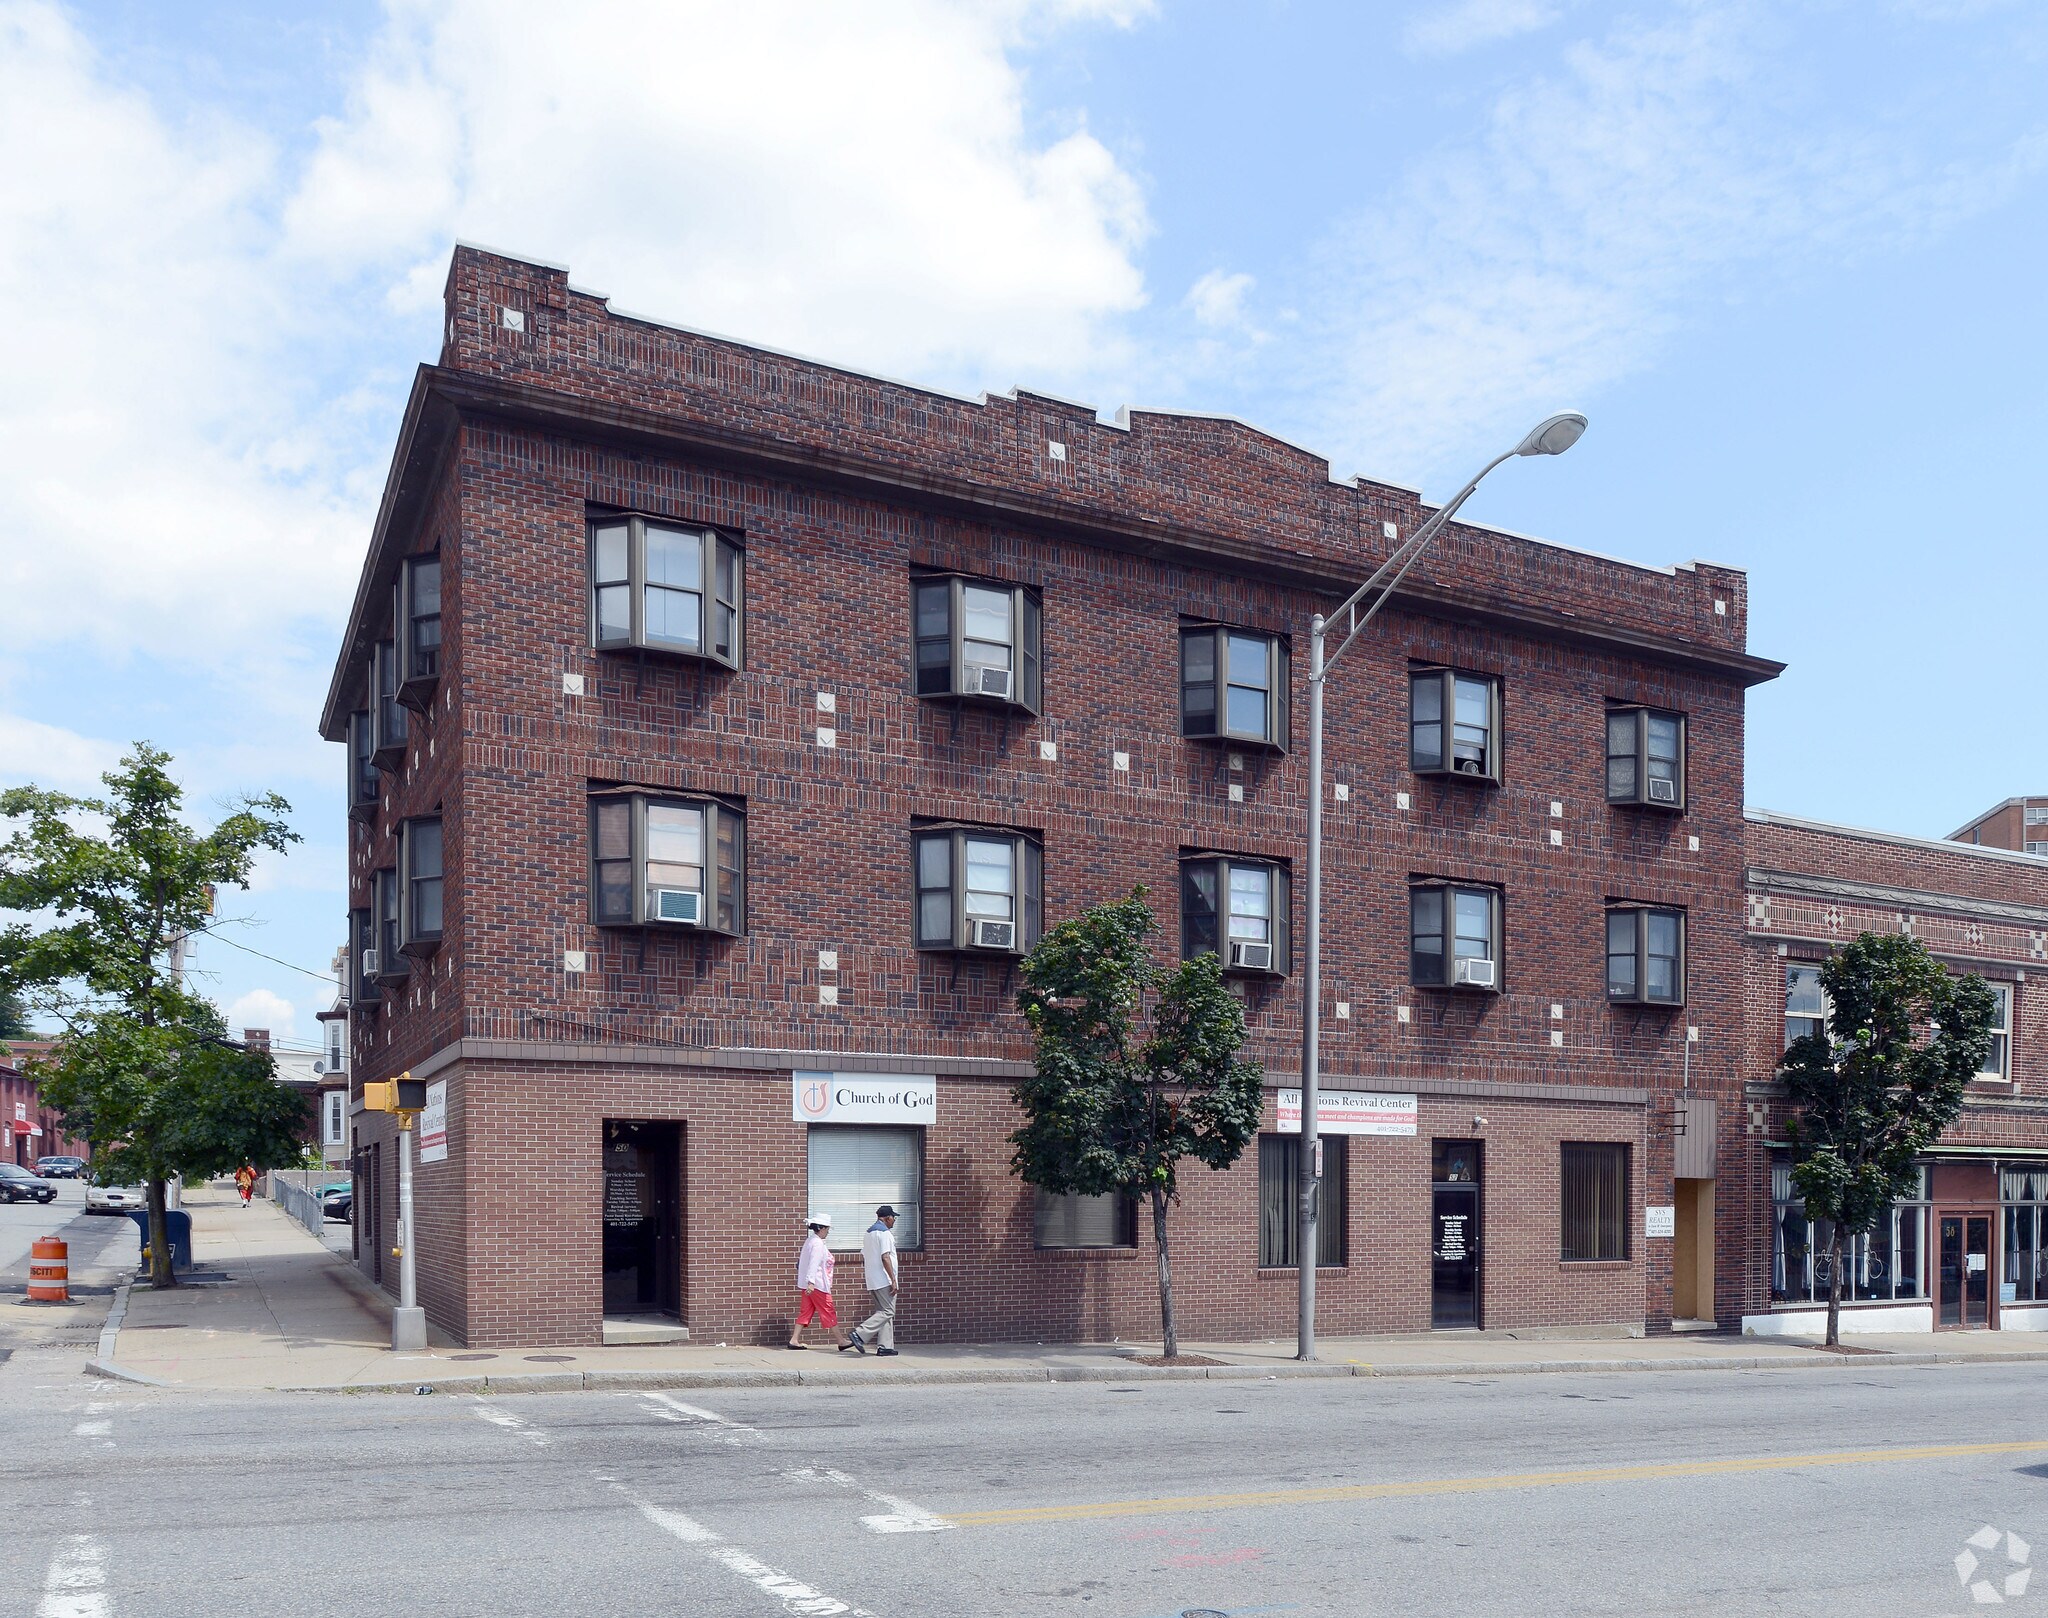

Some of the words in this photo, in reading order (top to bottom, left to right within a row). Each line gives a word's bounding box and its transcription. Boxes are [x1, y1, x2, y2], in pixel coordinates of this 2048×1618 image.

[835, 1088, 885, 1106] Church
[888, 1092, 901, 1104] of
[903, 1090, 933, 1108] God
[1283, 1093, 1298, 1104] All
[1342, 1096, 1378, 1108] Revival
[1380, 1098, 1413, 1109] Center
